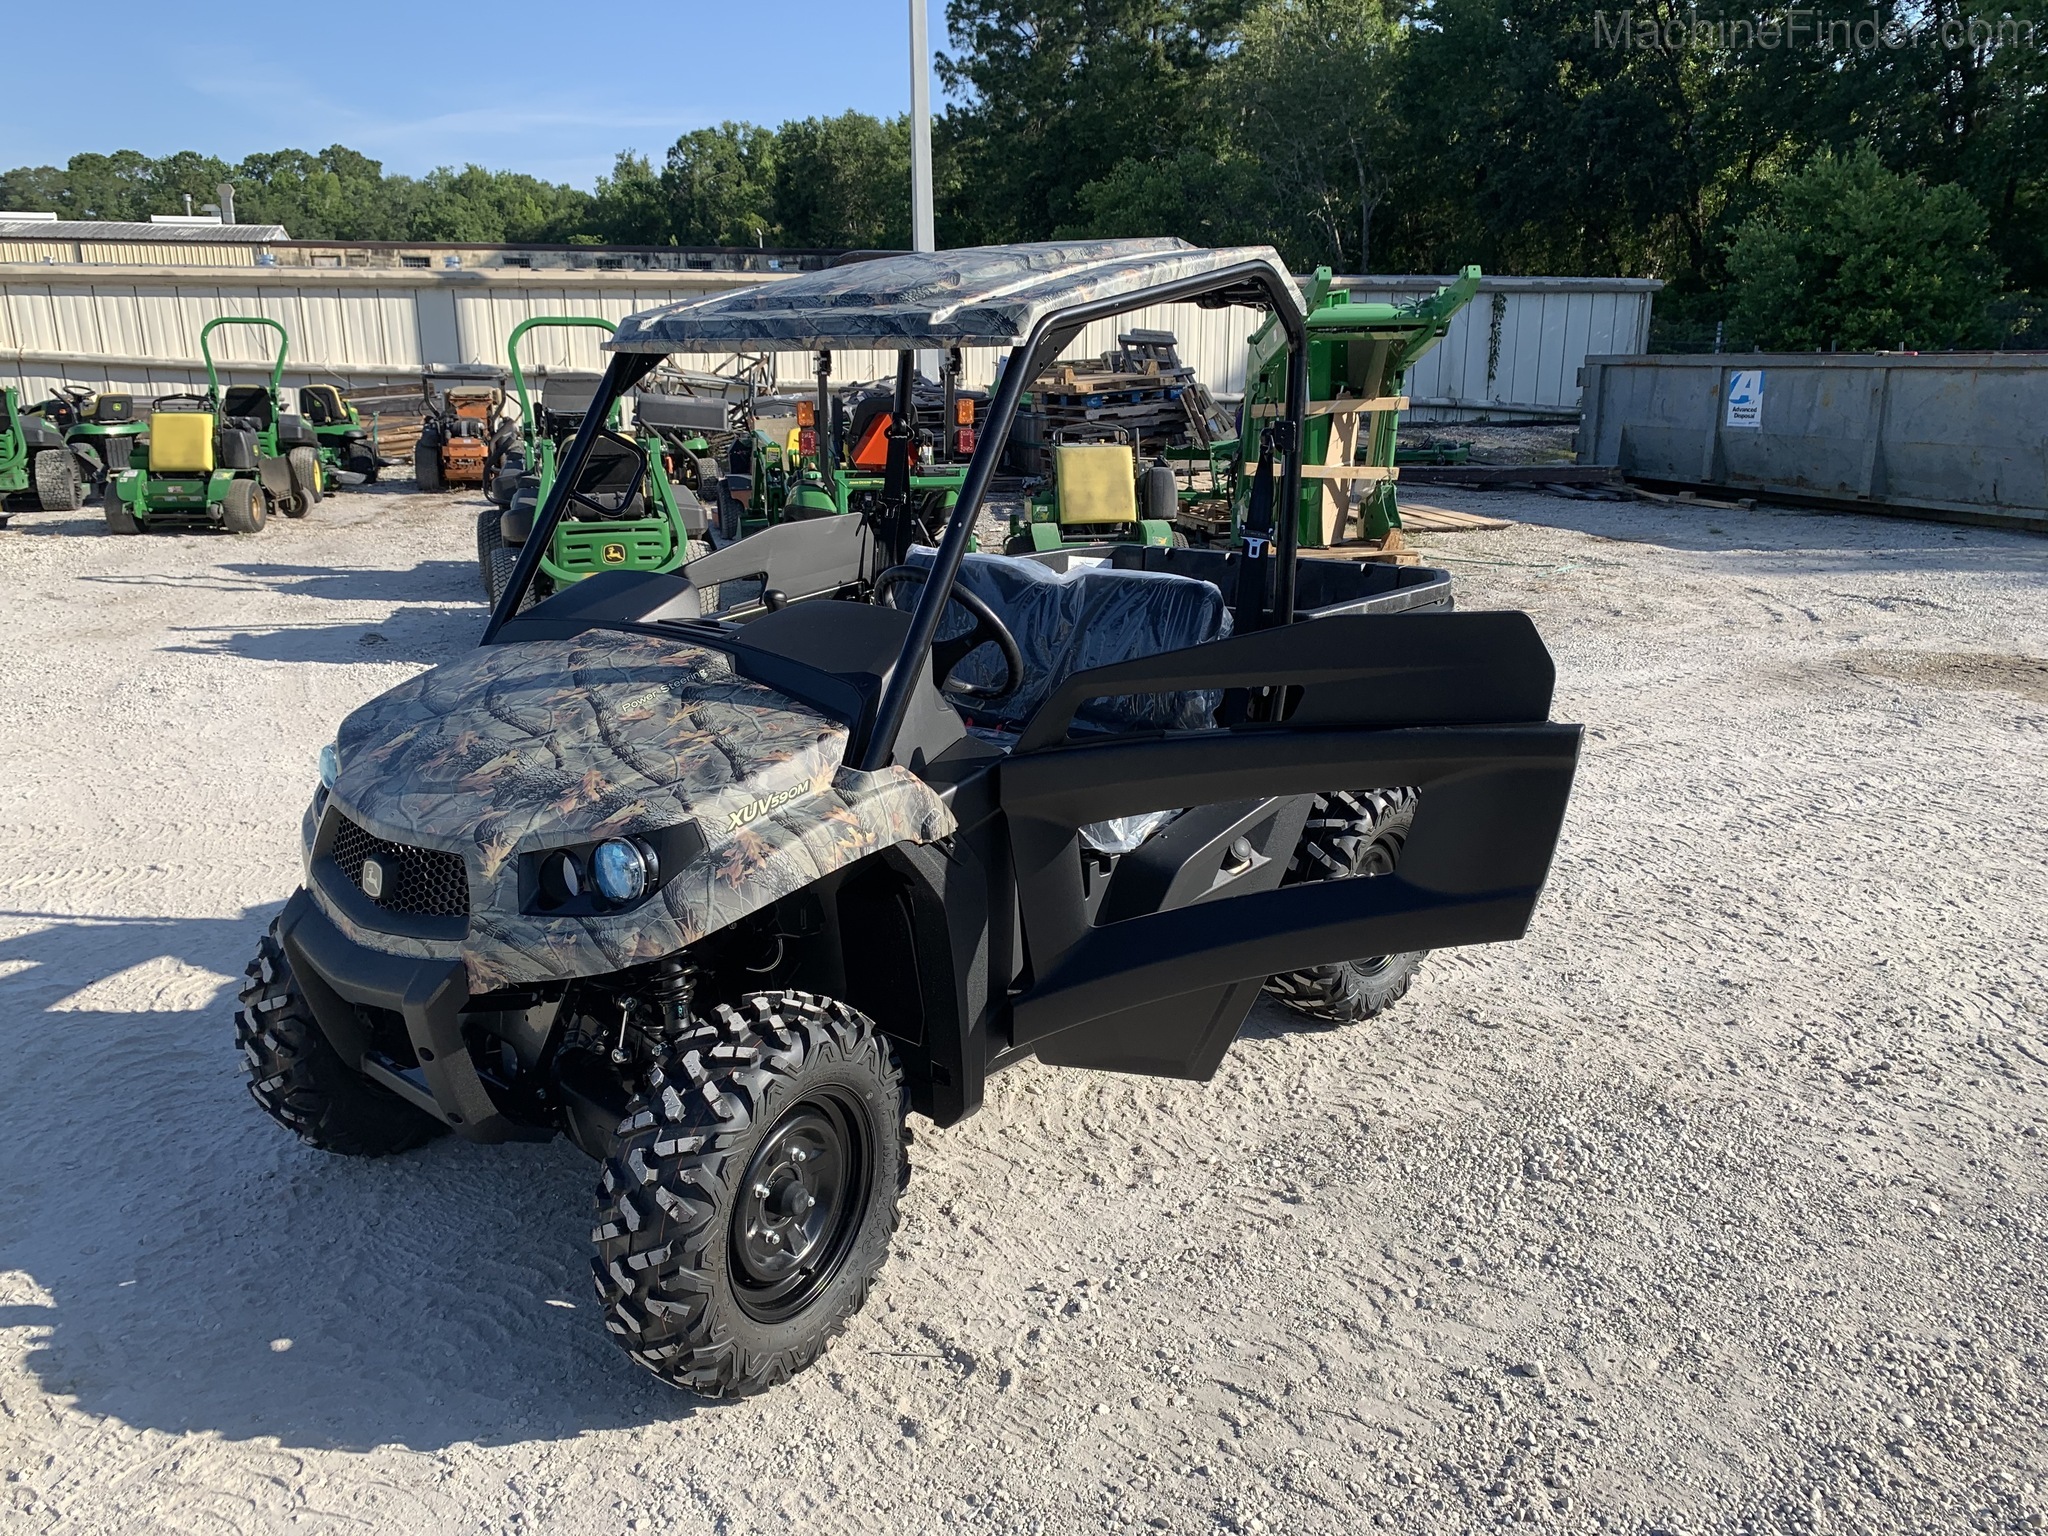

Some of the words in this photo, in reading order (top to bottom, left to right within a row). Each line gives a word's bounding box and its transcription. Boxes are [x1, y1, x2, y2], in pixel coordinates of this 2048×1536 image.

[621, 690, 657, 713] Power
[660, 668, 709, 694] Steering
[726, 779, 811, 834] XUV590M
